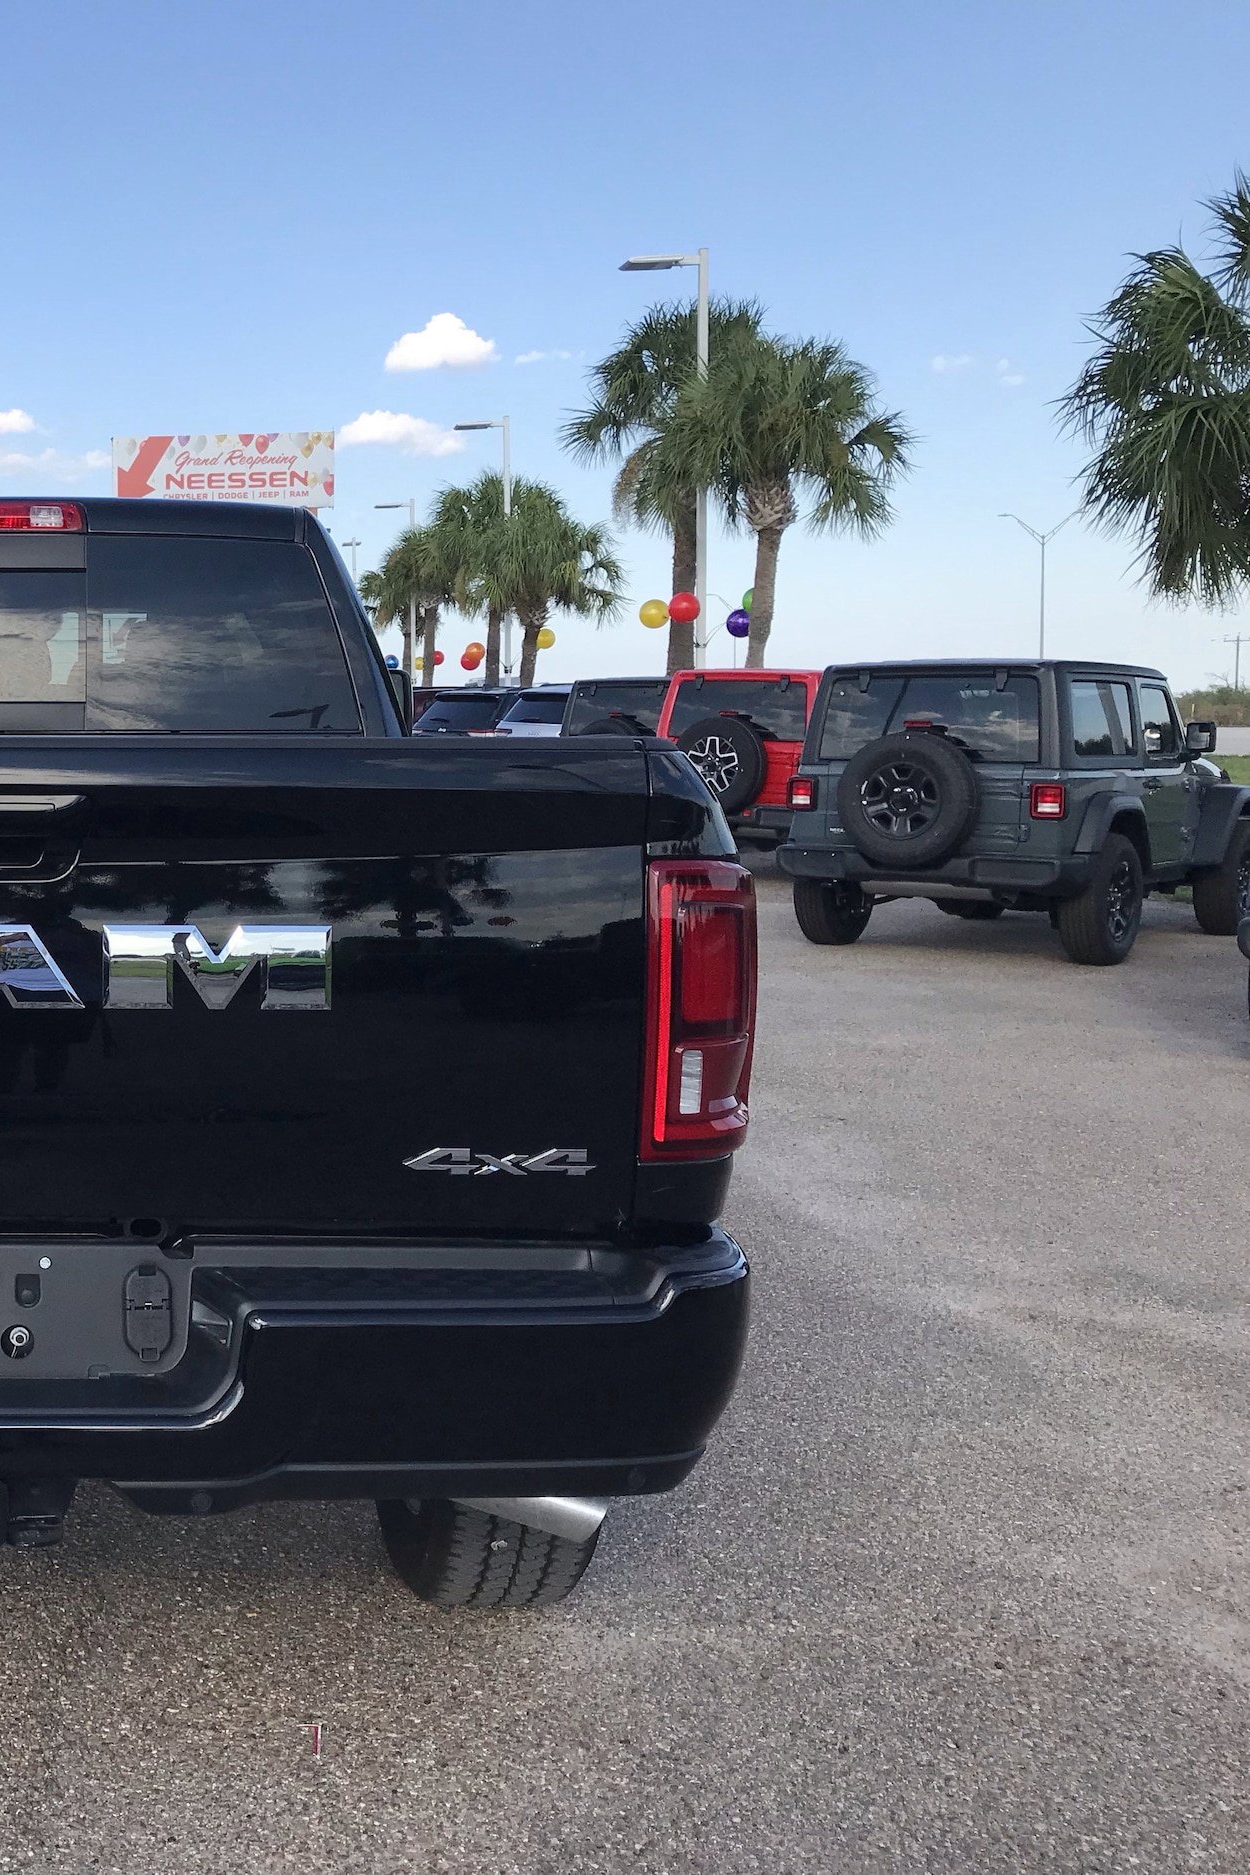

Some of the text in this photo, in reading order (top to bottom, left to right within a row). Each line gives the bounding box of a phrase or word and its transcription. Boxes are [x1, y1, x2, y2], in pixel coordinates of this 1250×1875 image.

[174, 449, 298, 474] Grand Reopening
[165, 470, 309, 490] NEESSEN
[218, 491, 249, 500] DODGE
[258, 490, 280, 499] JEEP
[289, 490, 309, 498] RAM
